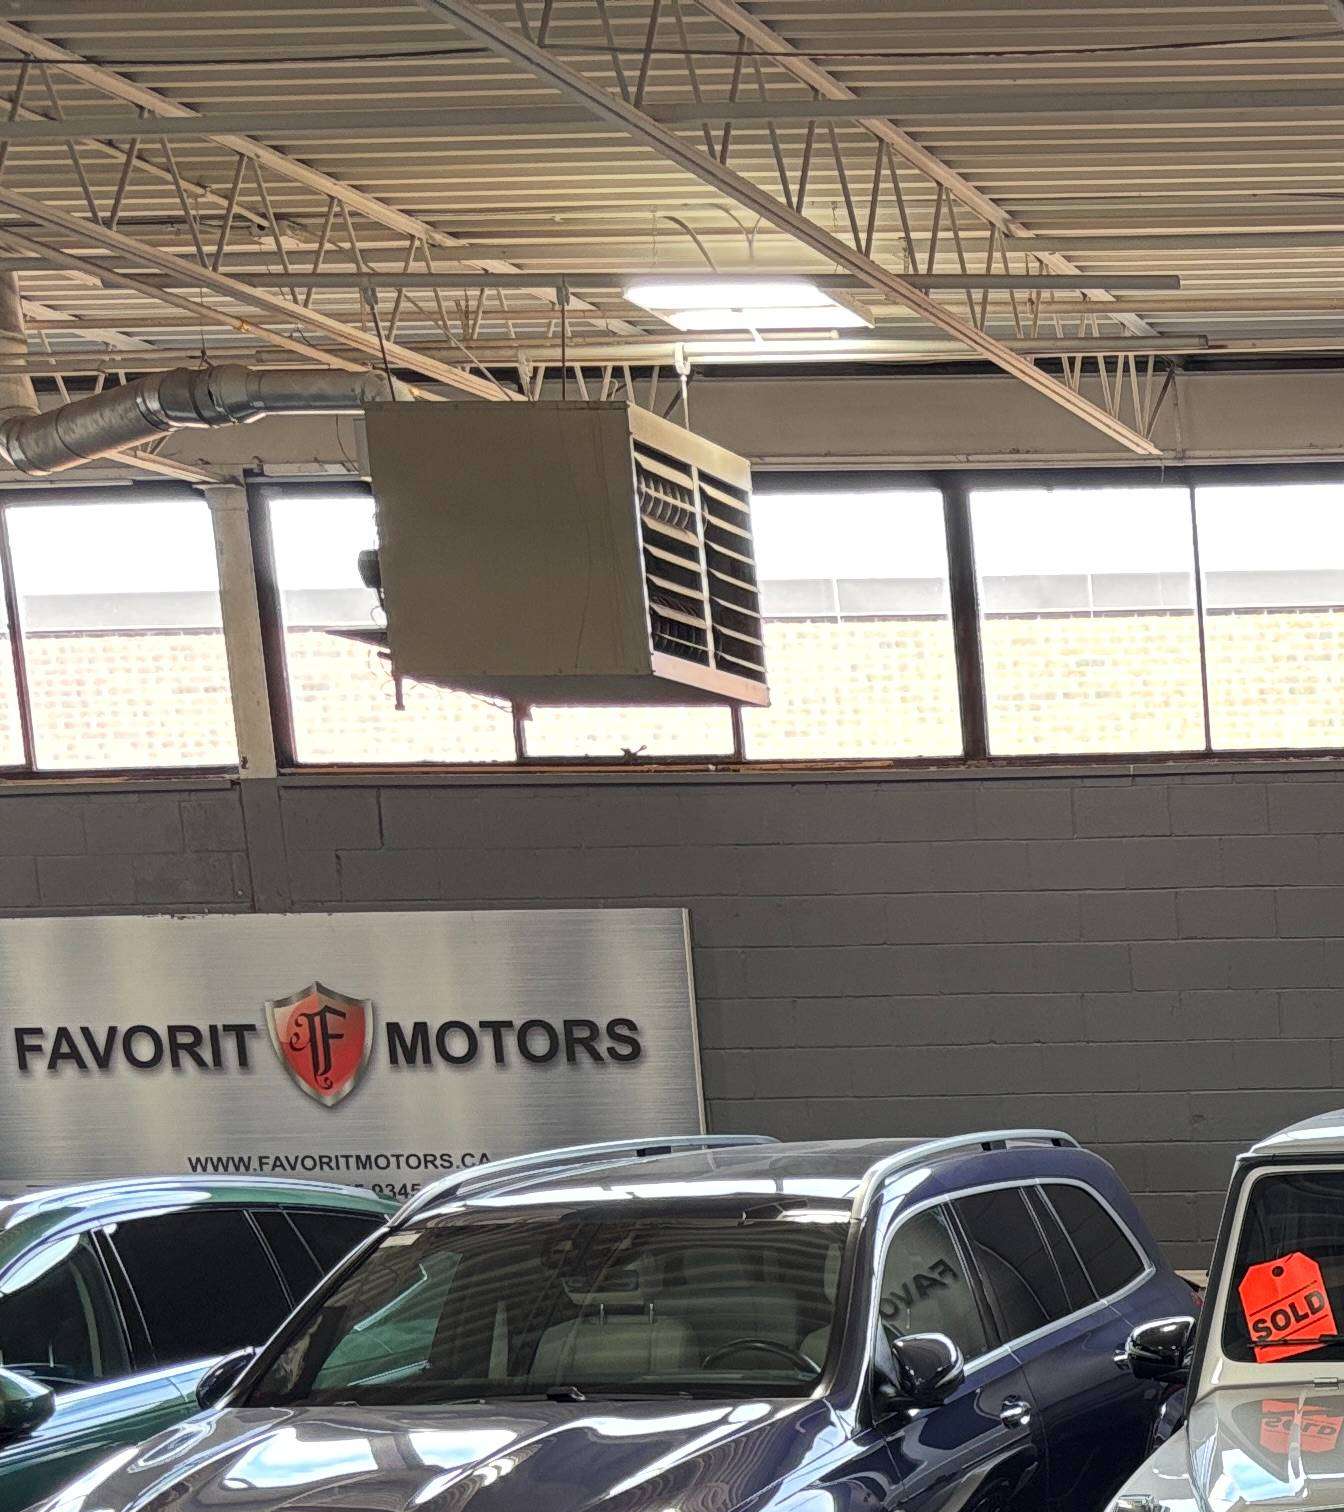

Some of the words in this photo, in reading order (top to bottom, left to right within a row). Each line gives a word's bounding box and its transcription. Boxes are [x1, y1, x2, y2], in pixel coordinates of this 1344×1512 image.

[14, 1023, 257, 1071] FAVORIT
[386, 1018, 642, 1066] MOTORS
[188, 1152, 491, 1173] WWW.FAVORITMOTORS.CA
[1252, 1290, 1325, 1341] SOLD
